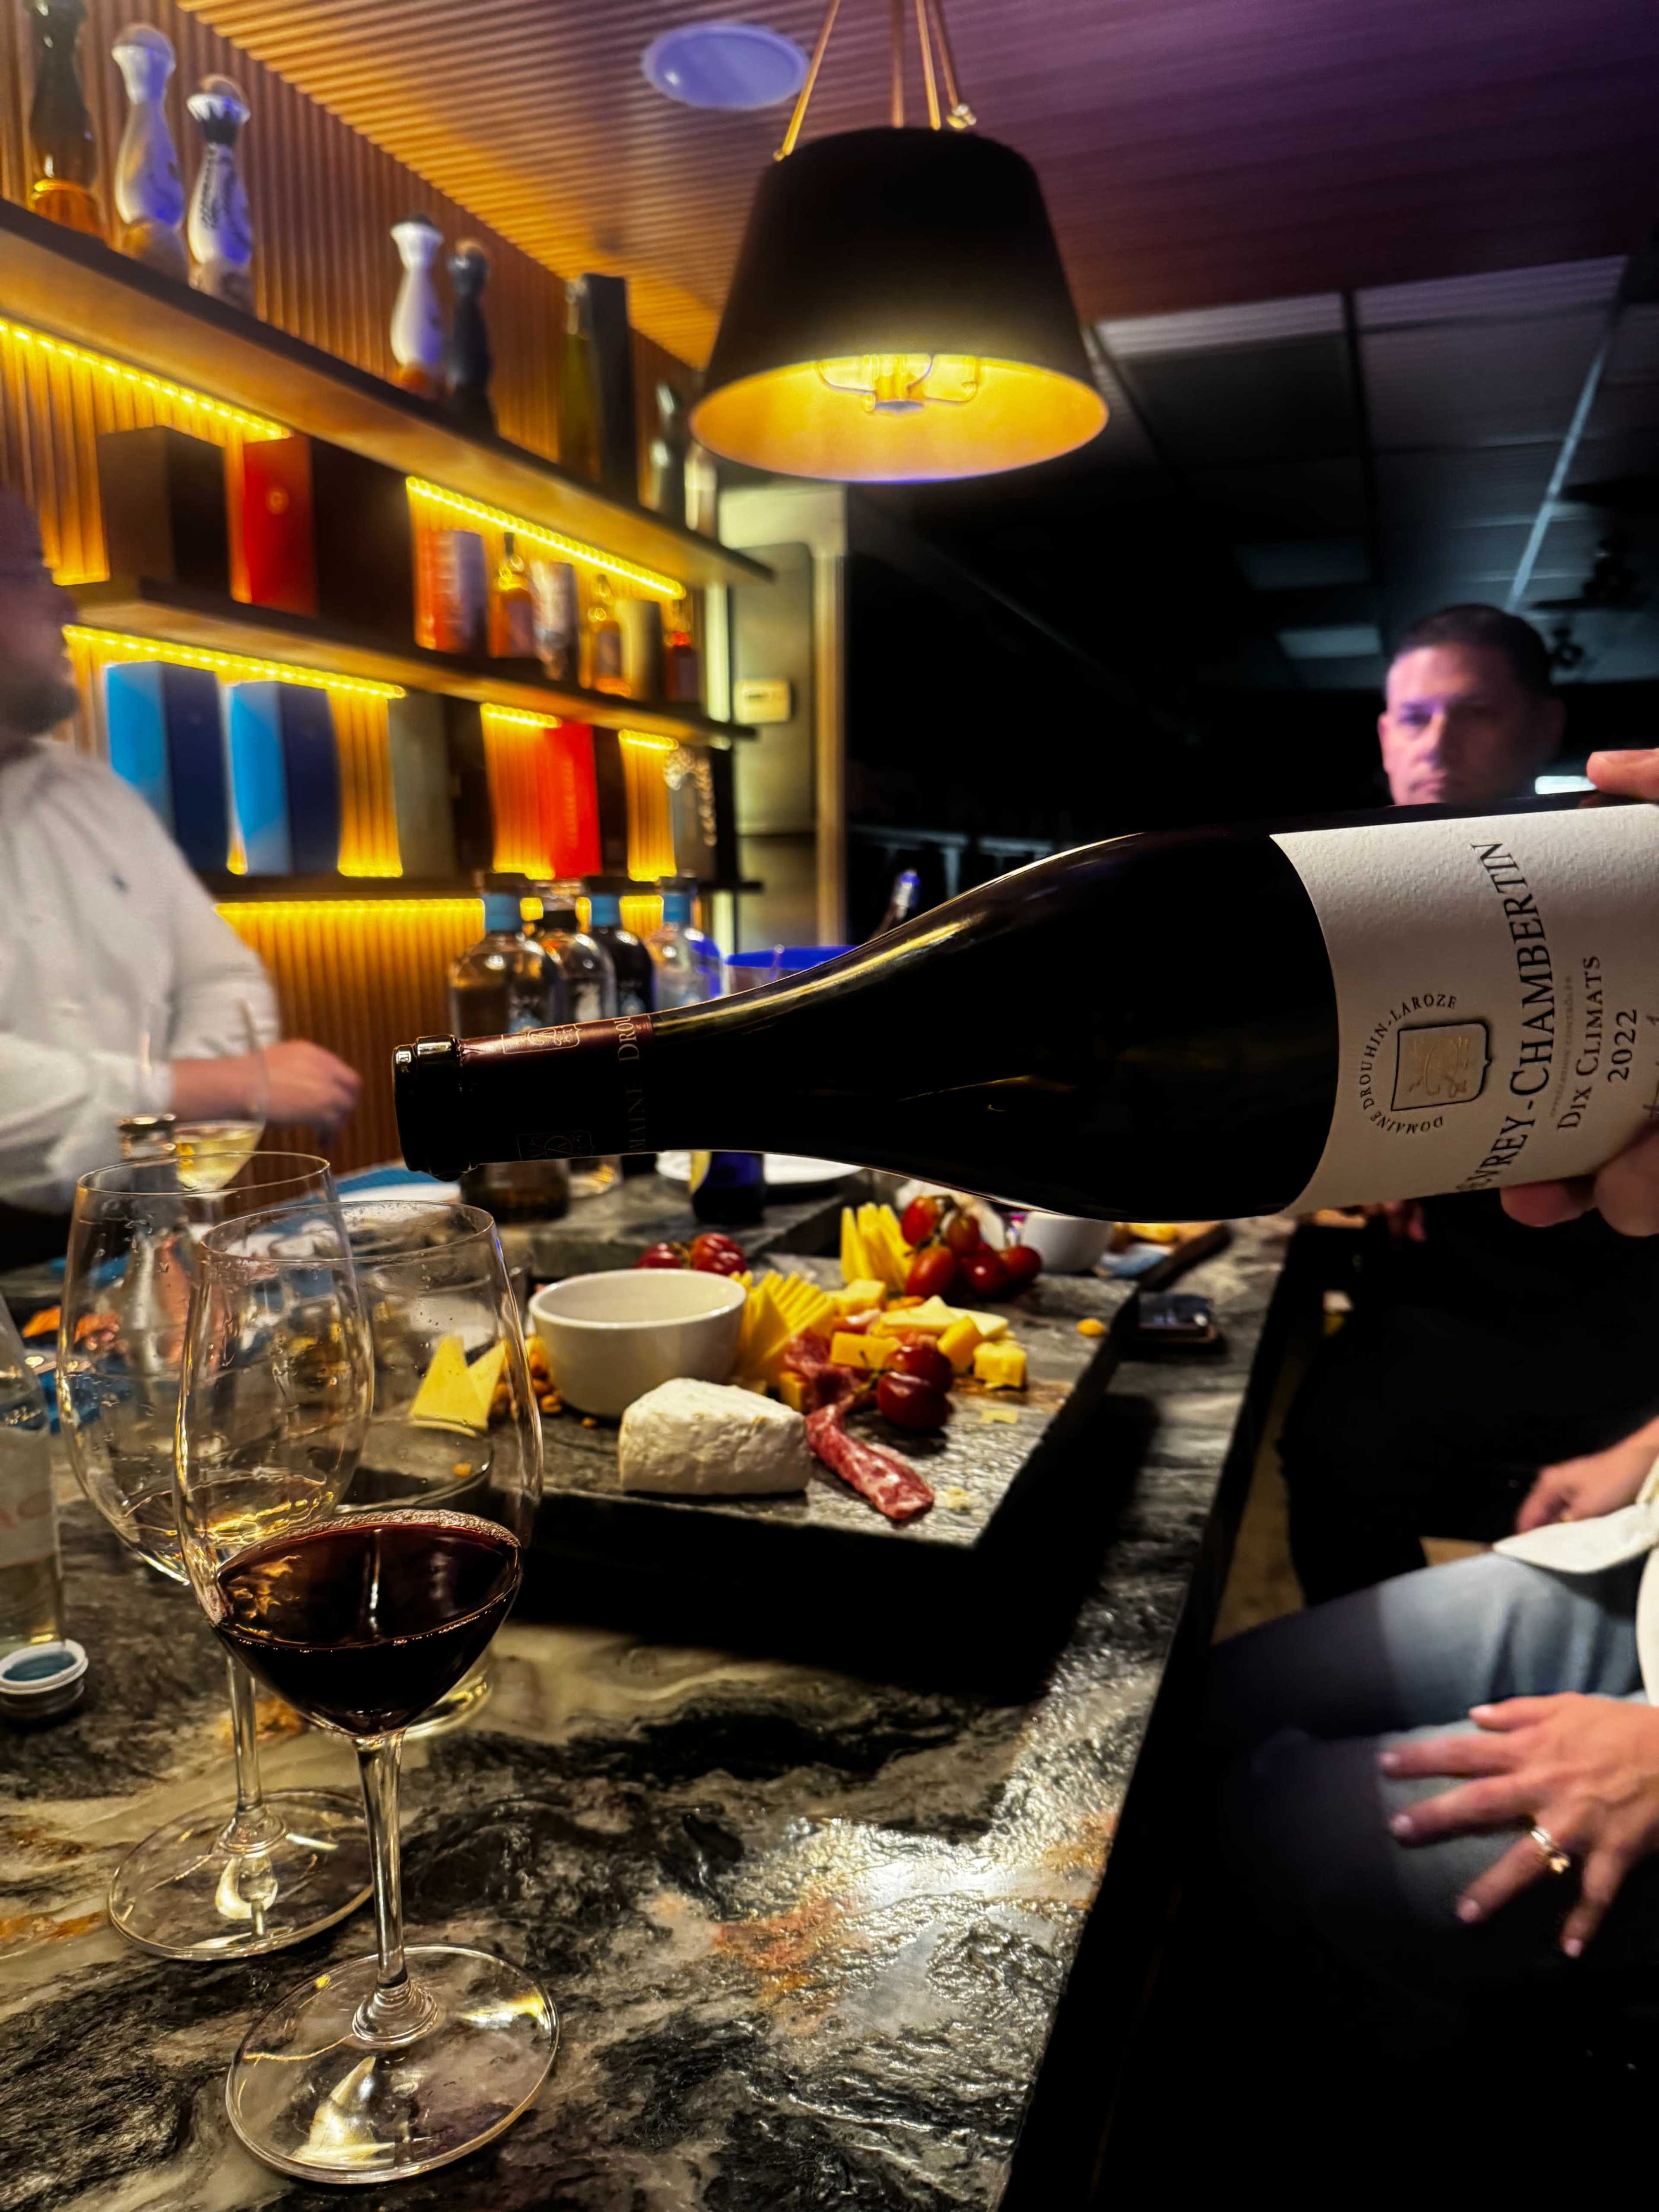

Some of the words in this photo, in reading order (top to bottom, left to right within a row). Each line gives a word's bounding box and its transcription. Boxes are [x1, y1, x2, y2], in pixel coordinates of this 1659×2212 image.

[1359, 993, 1457, 1111] DROUHIN-LAROZE
[1607, 1009, 1637, 1083] 2022
[1370, 1110, 1443, 1134] DOMAINE
